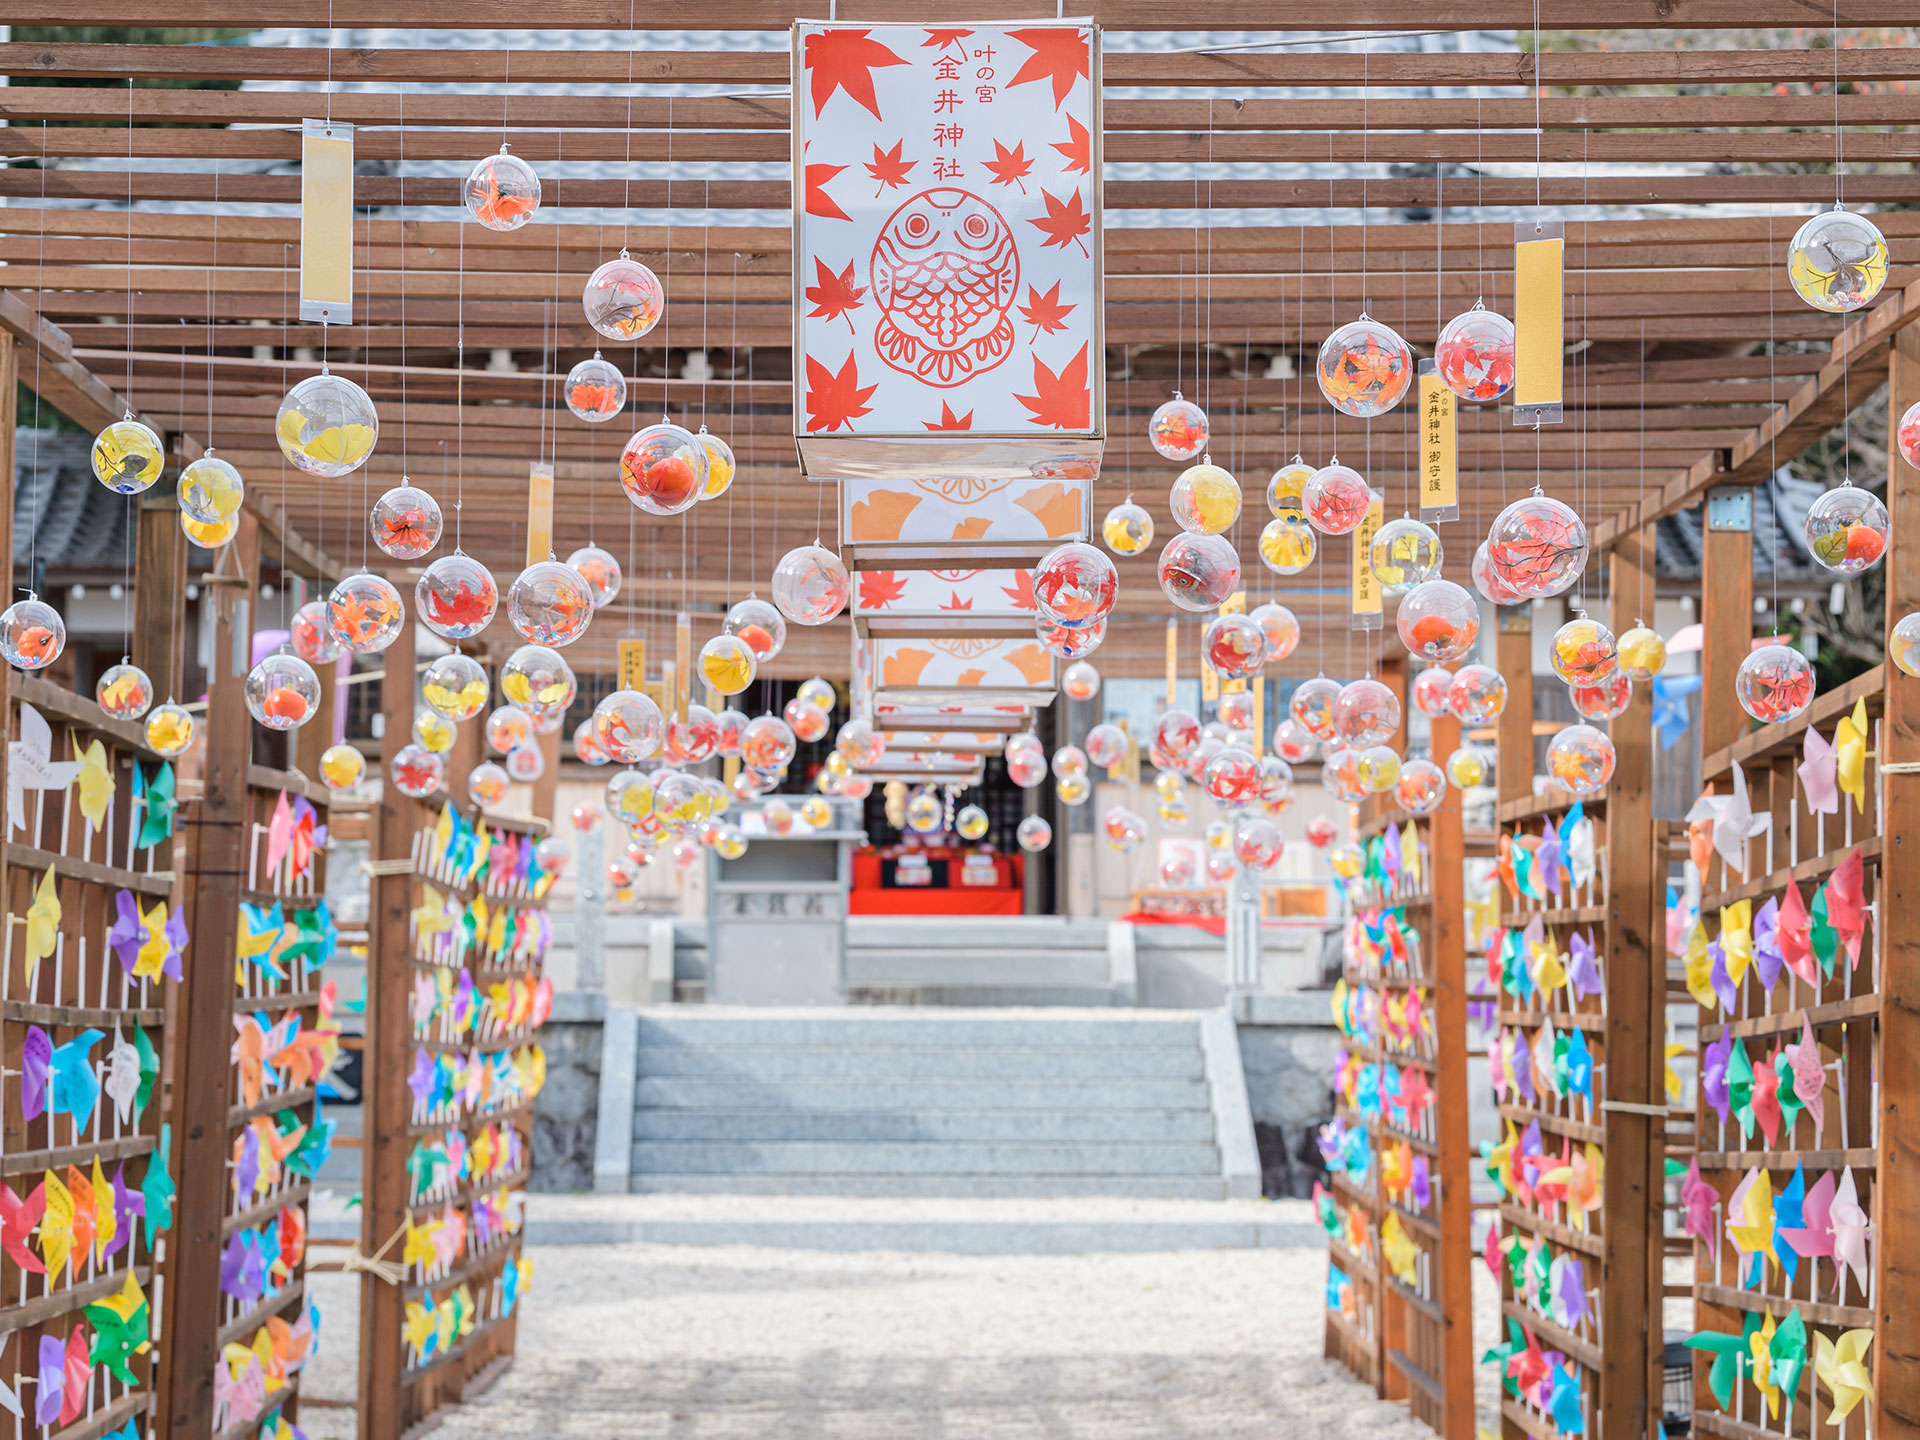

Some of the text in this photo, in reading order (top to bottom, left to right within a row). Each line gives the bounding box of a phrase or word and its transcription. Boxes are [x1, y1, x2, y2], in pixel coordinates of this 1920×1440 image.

[932, 54, 965, 182] 金井神社
[973, 44, 997, 103] 叶の宮
[1428, 391, 1441, 492] 金井神社 御守護
